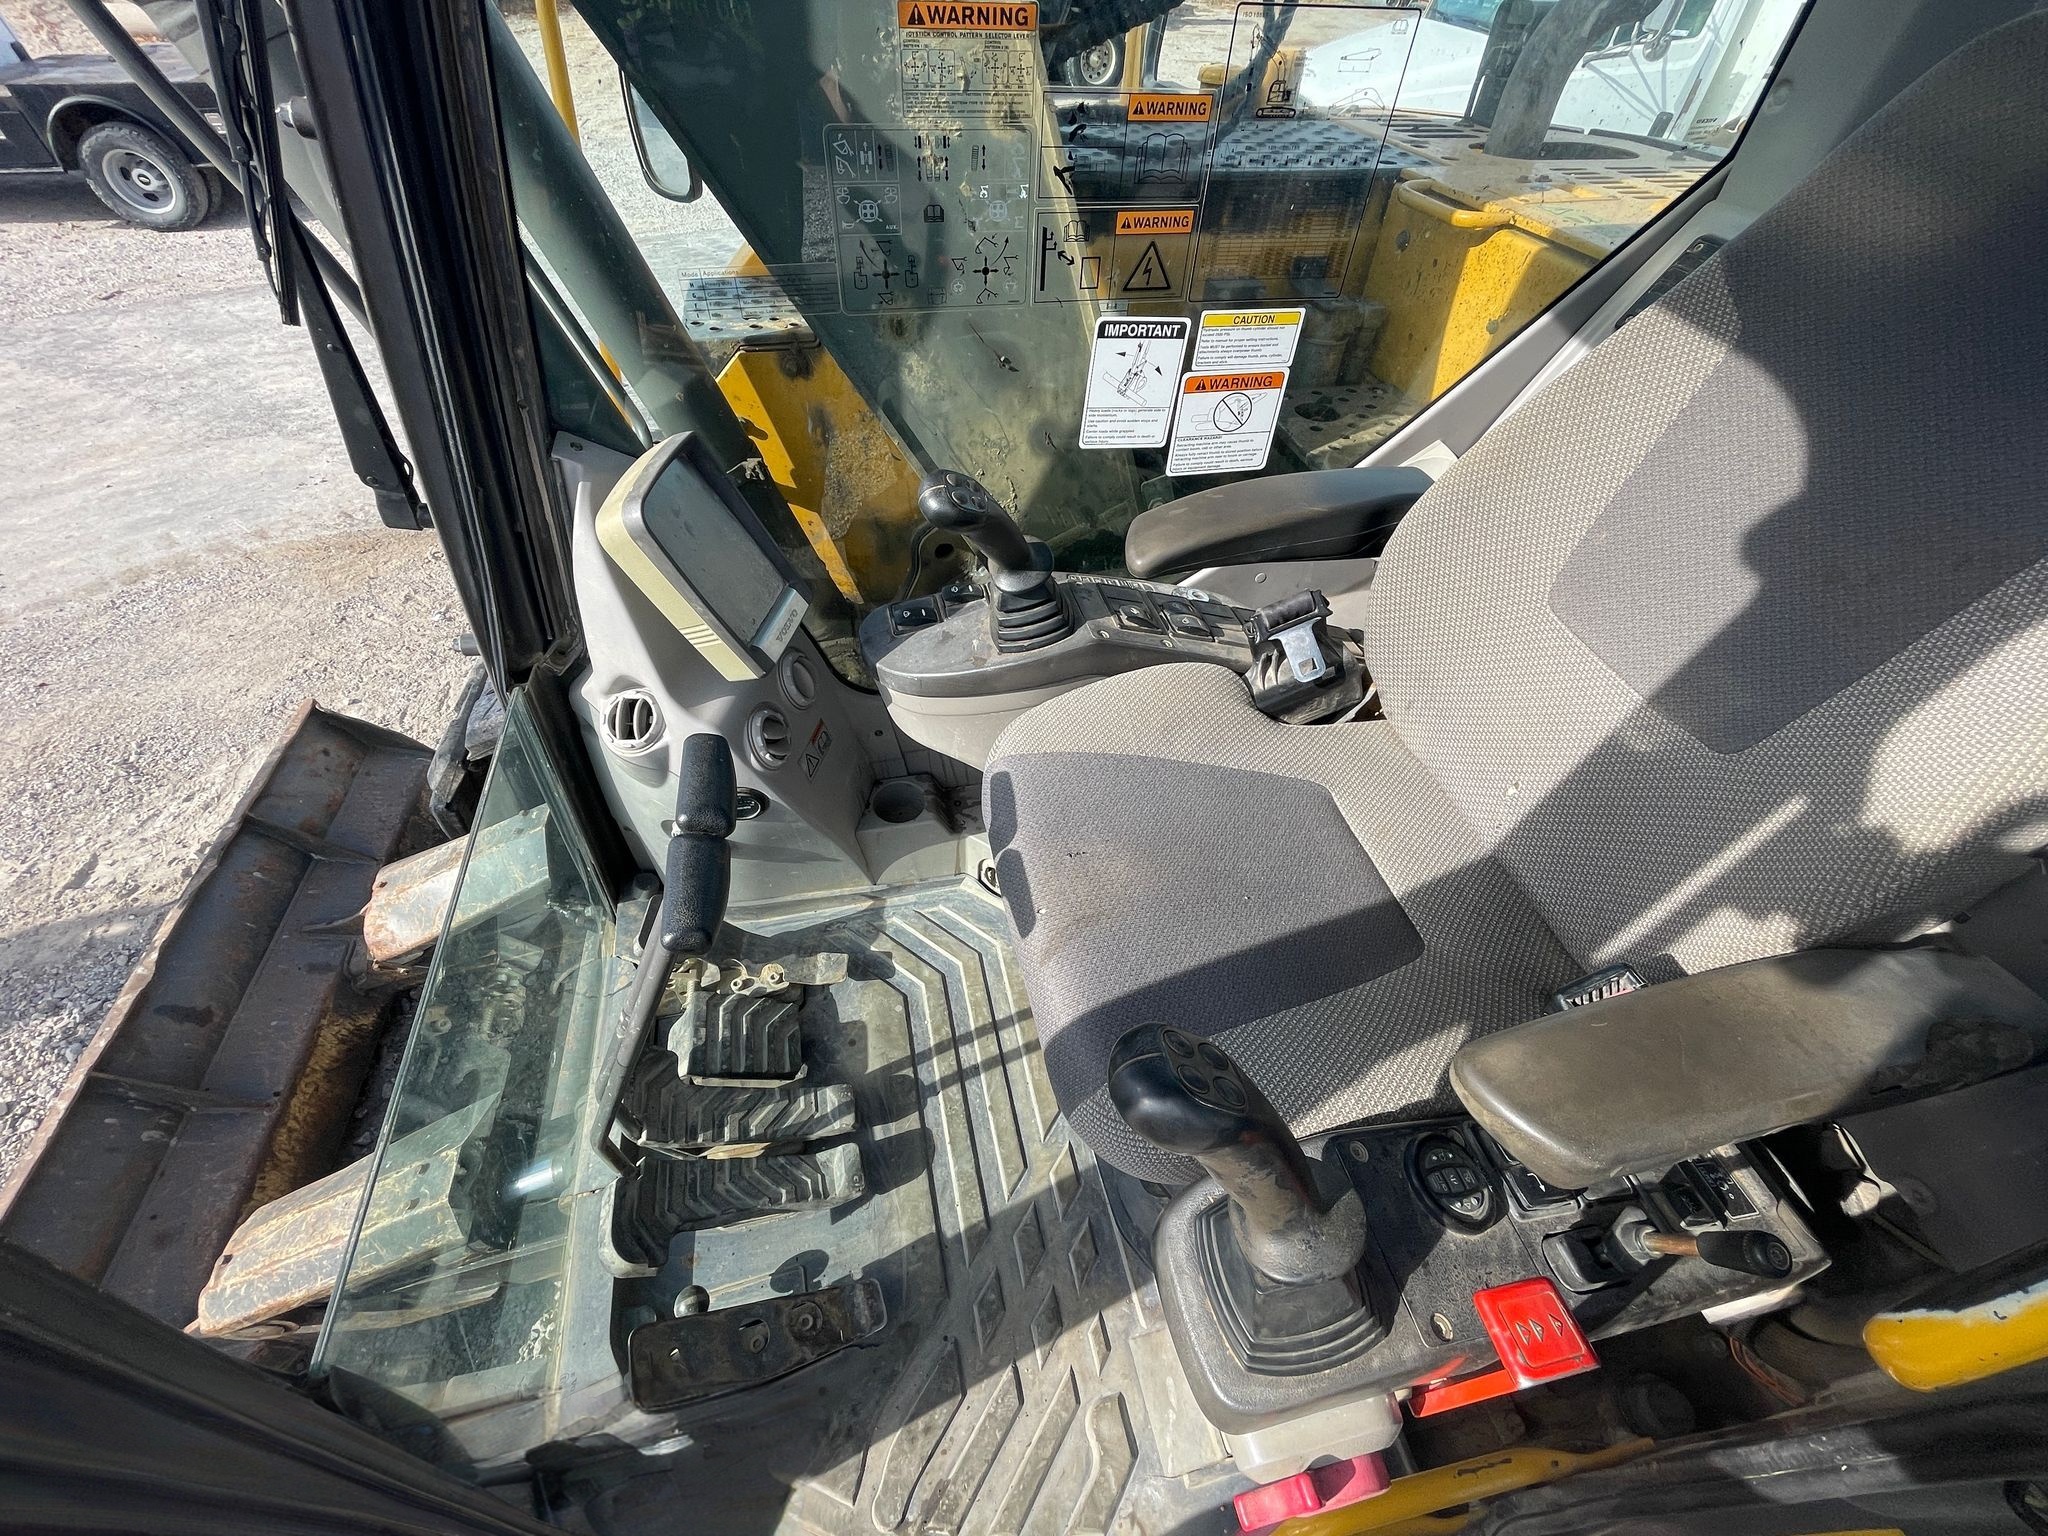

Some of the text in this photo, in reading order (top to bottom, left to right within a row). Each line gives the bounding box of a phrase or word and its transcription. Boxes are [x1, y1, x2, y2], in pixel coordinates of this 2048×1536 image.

[926, 5, 1028, 26] WARNING
[1146, 102, 1206, 115] WARNING
[1133, 216, 1189, 228] WARNING
[1233, 314, 1275, 325] CAUTION
[1104, 324, 1180, 338] IMPORTANT
[1209, 376, 1272, 390] WARNING
[776, 608, 798, 642] VOLVO
